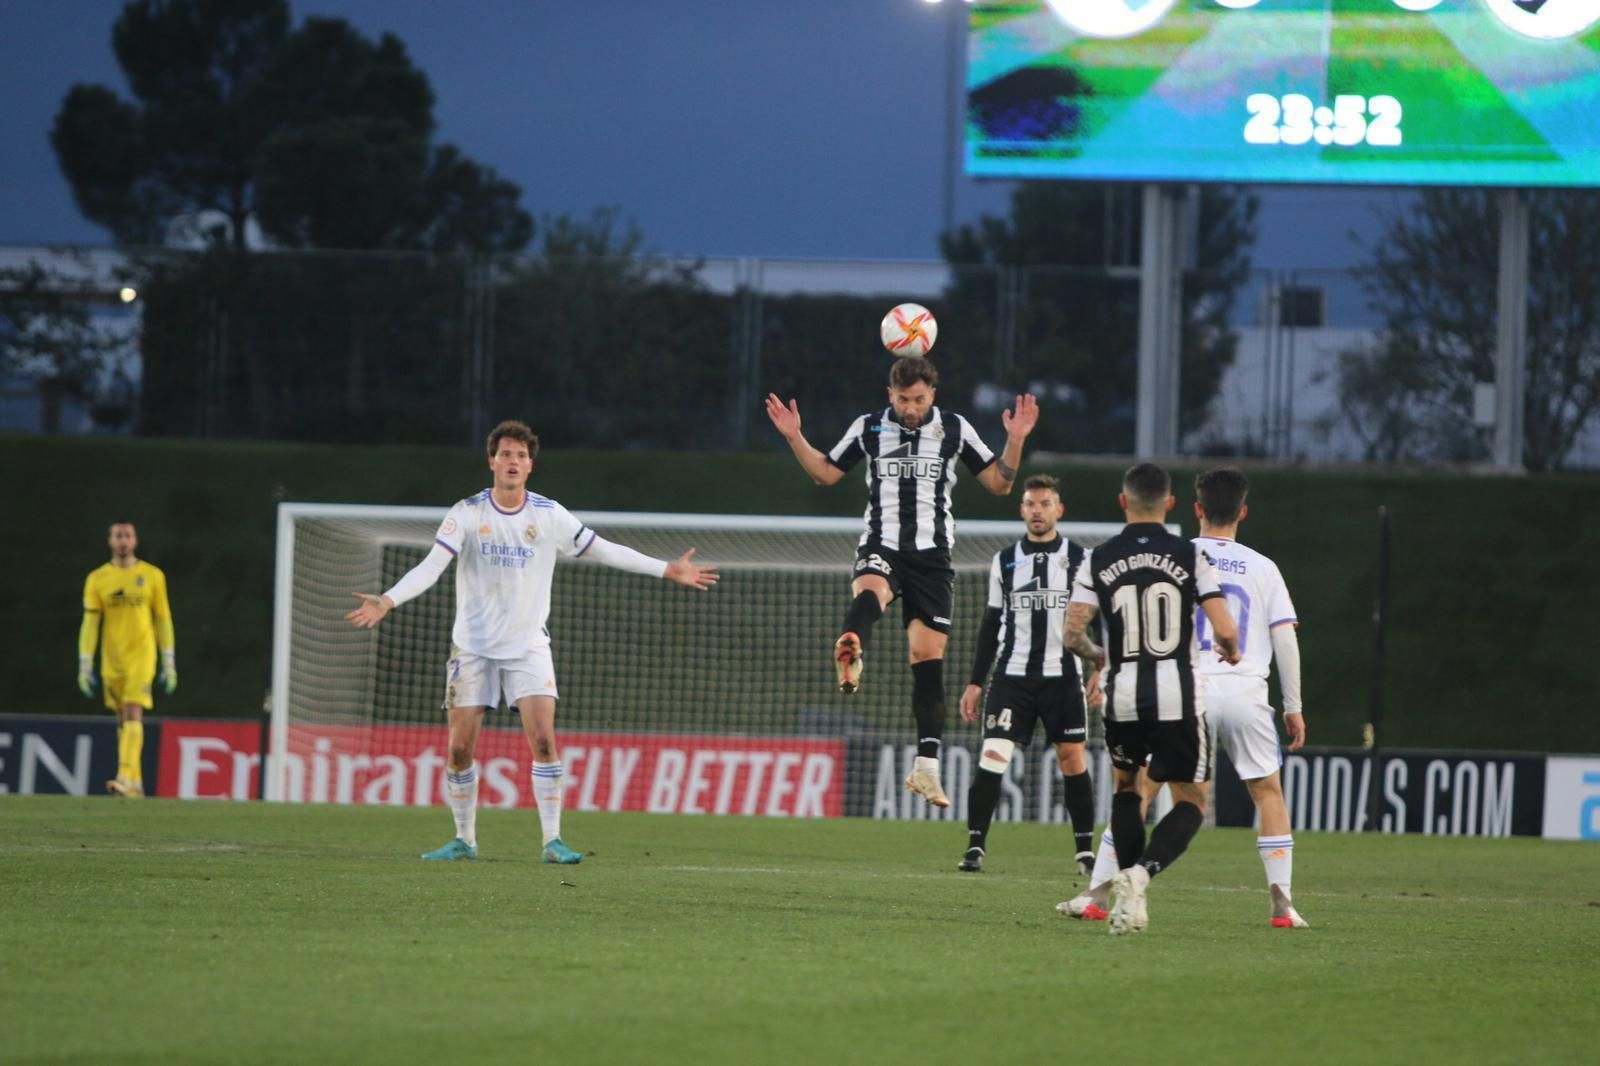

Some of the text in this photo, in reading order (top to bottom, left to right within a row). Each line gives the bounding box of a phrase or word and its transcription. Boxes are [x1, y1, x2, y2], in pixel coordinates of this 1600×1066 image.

[1243, 93, 1402, 147] 23:52
[877, 460, 943, 480] LOTUS
[481, 541, 535, 559] Emirates
[1127, 553, 1189, 585] GONZÁLEZ
[1217, 557, 1248, 575] IBAS
[1011, 592, 1069, 610] LOTUS
[1111, 582, 1183, 657] 10
[997, 708, 1012, 731] 4
[0, 732, 92, 796] N
[177, 736, 834, 818] Emirats FLY BETTER
[873, 744, 1025, 825] ADDS
[1253, 755, 1408, 836] DIDS
